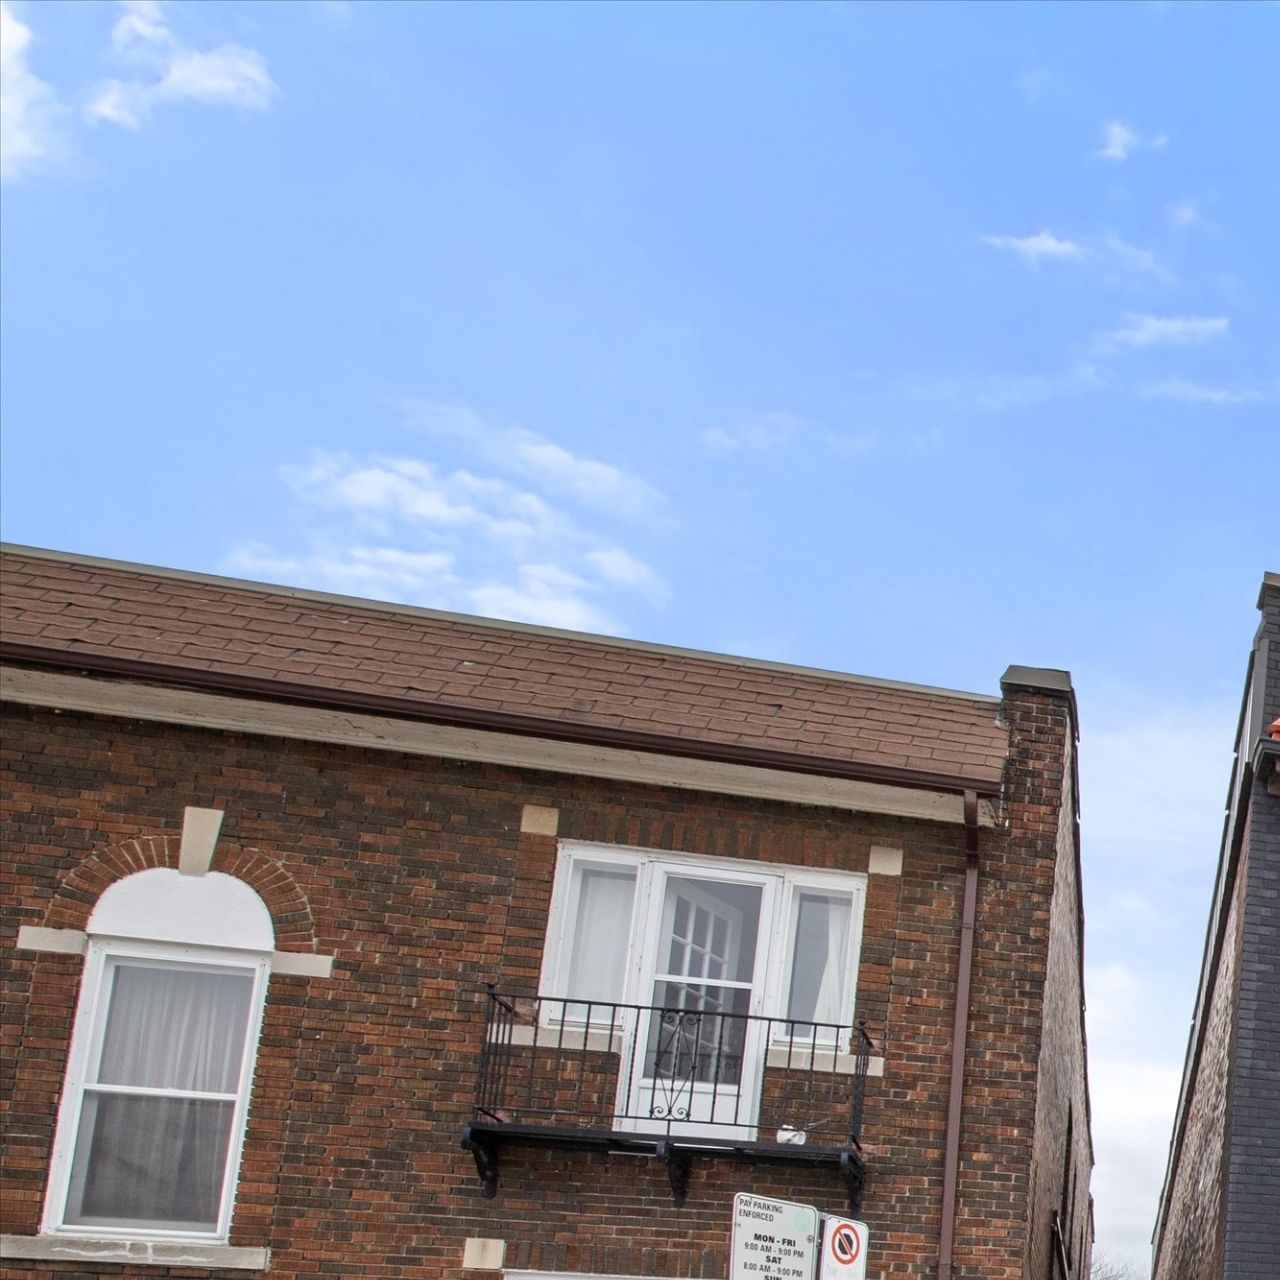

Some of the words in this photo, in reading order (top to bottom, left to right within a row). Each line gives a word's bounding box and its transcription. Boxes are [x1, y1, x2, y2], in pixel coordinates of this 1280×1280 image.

[739, 1199, 753, 1207] PAY
[753, 1201, 783, 1214] PARKING
[739, 1209, 774, 1222] ENFORCED
[754, 1233, 775, 1244] MON
[781, 1238, 796, 1247] FRI
[744, 1242, 759, 1251] 9:00
[760, 1244, 772, 1253] AM
[778, 1248, 792, 1257] 9:00
[793, 1249, 804, 1258] PM
[765, 1255, 783, 1264] SAT
[759, 1264, 771, 1273] AM
[777, 1267, 791, 1276] 9:00
[792, 1269, 803, 1277] PM
